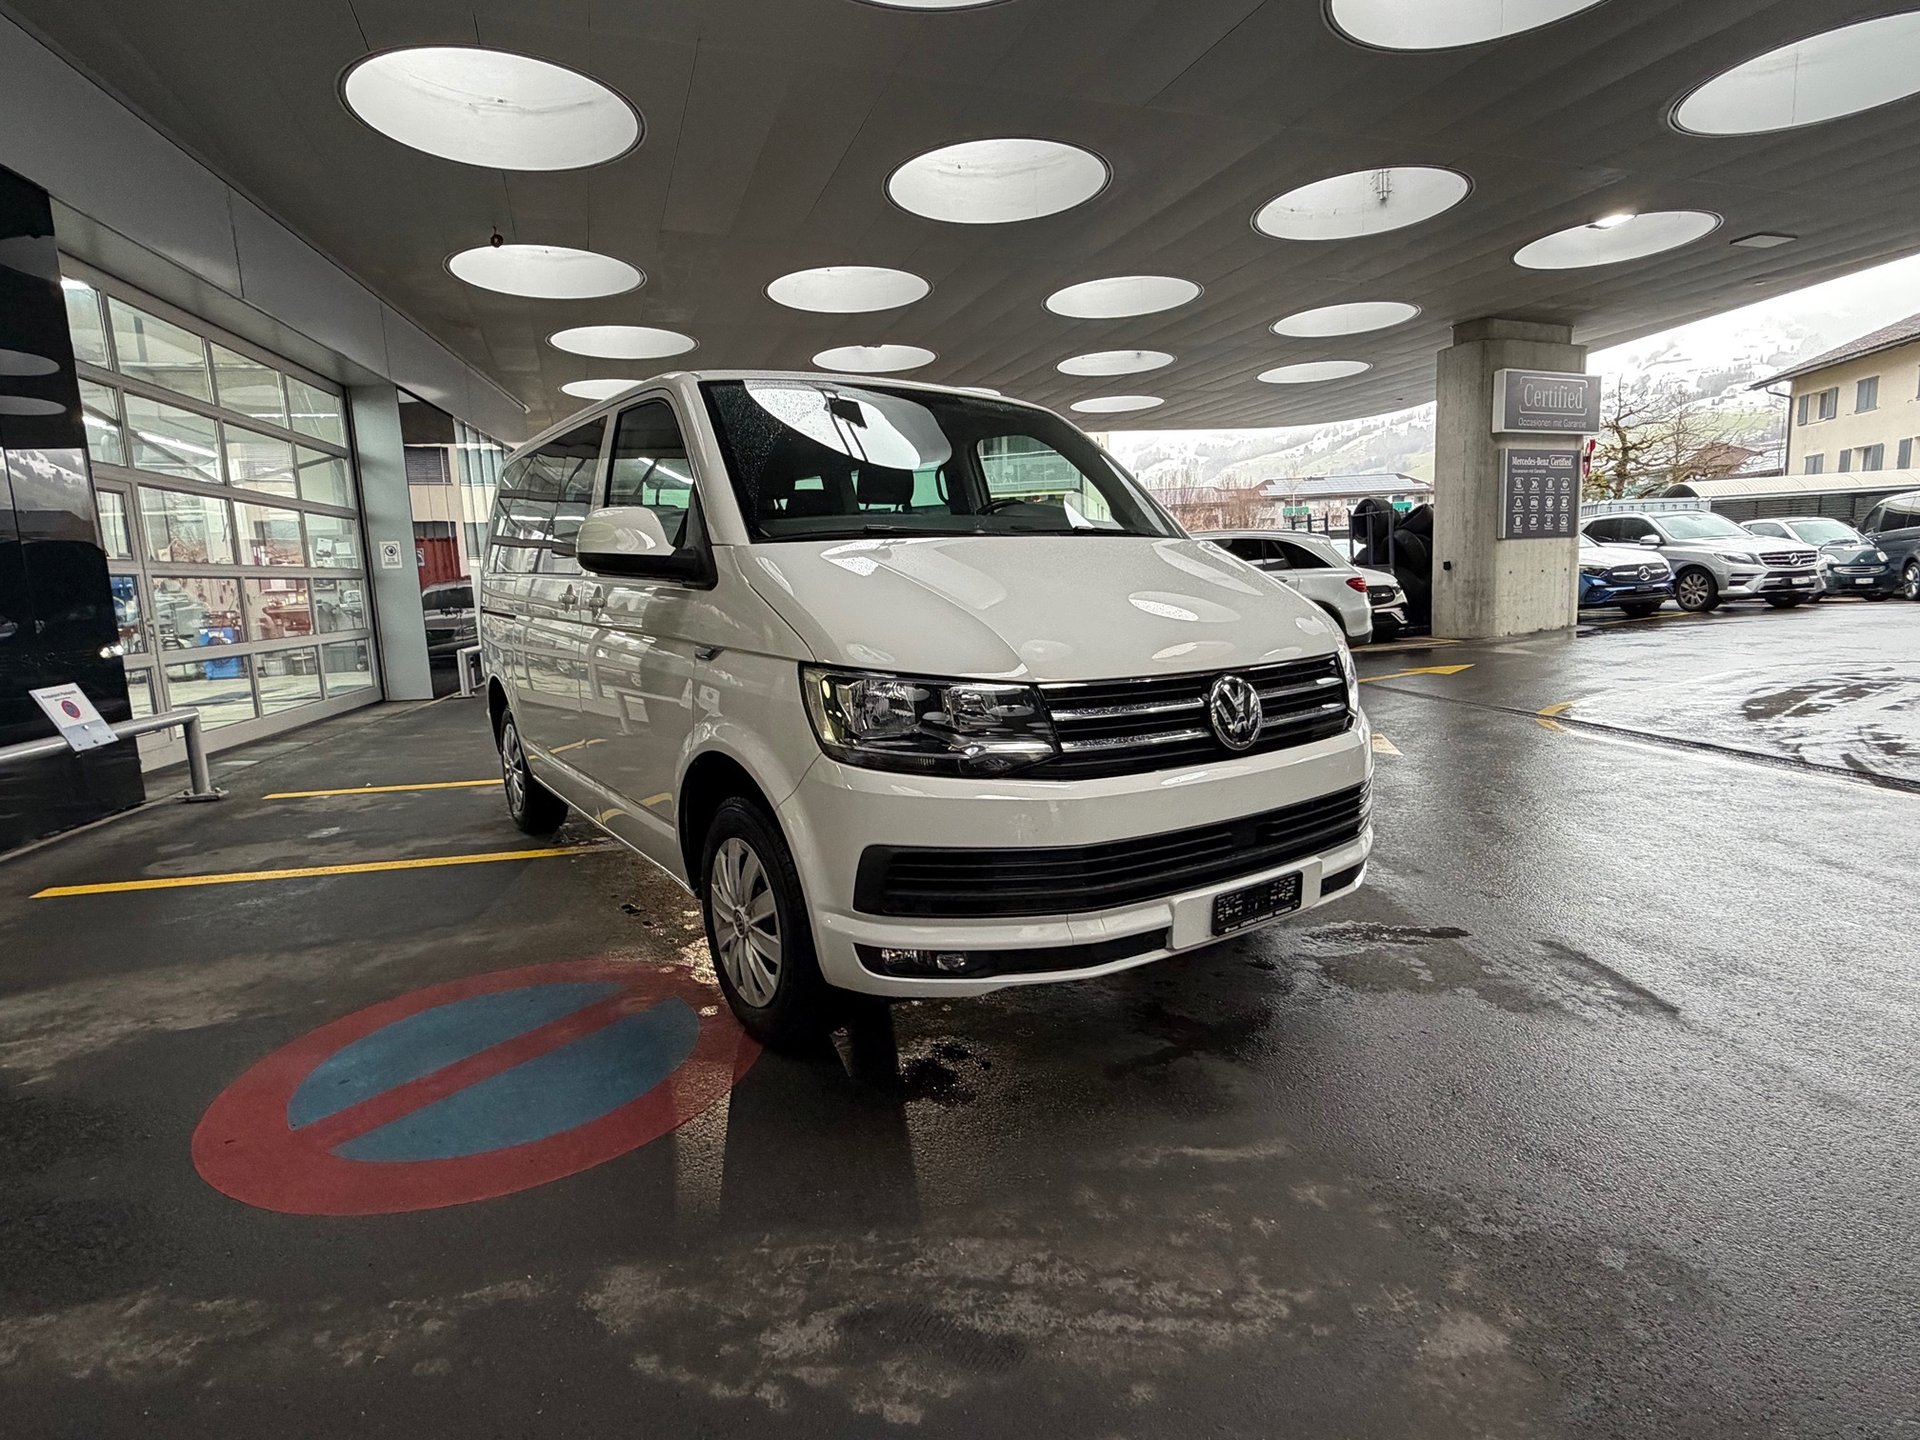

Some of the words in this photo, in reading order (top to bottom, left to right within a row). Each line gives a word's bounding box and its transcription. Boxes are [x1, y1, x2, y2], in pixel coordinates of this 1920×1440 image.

[1524, 383, 1583, 409] Certified
[1511, 456, 1549, 466] Mercedes-Benz
[1550, 457, 1572, 466] Certified
